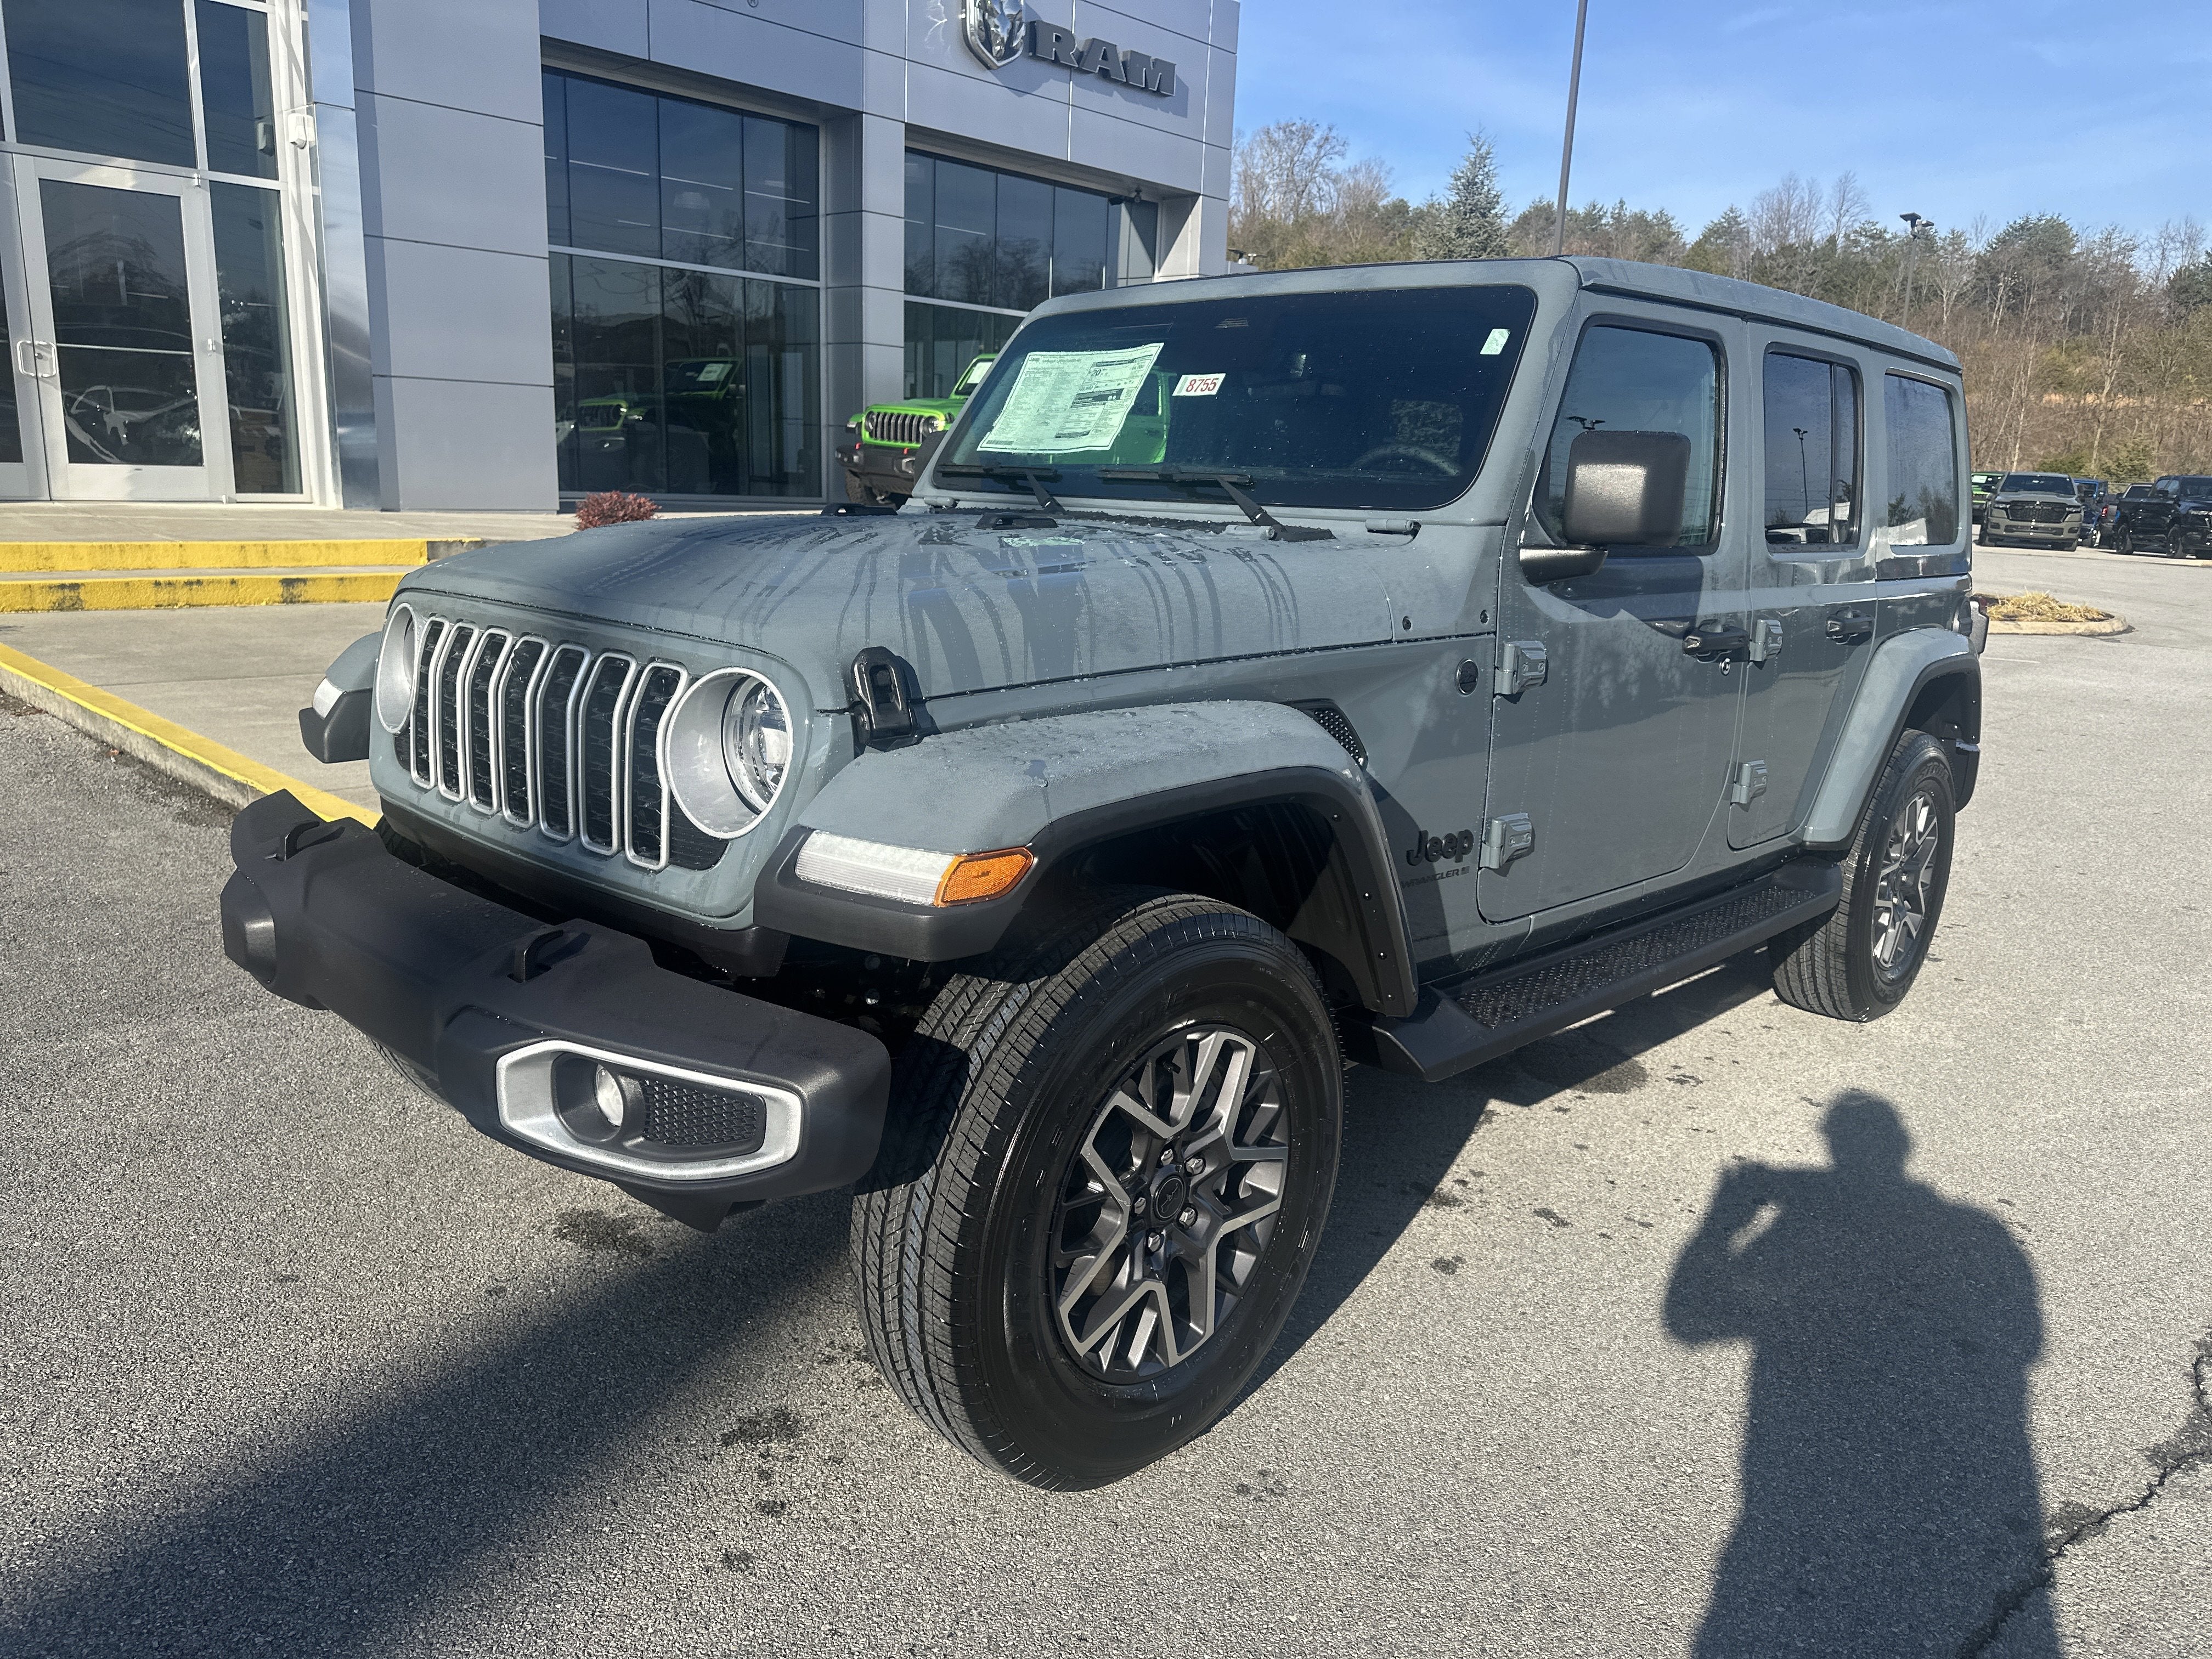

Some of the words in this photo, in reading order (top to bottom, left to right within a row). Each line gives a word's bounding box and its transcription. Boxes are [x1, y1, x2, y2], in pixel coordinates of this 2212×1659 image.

[1032, 20, 1176, 97] RAM
[1186, 377, 1219, 392] 8755
[1406, 829, 1474, 866] Jeep
